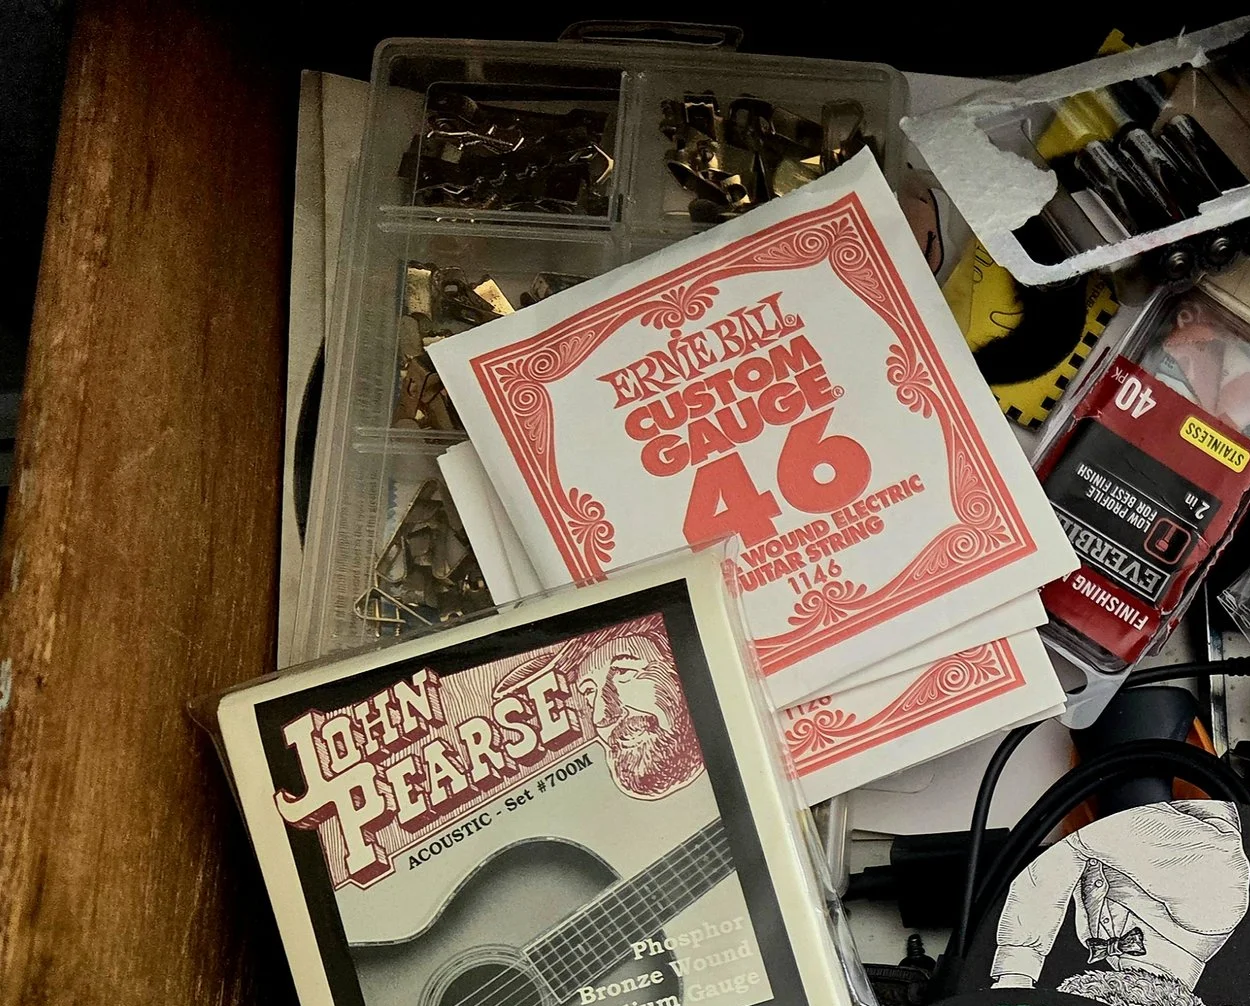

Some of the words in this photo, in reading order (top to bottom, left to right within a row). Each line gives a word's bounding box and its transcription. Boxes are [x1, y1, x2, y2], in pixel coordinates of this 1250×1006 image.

[596, 329, 717, 409] ERNIE
[707, 292, 805, 364] BALL
[625, 335, 822, 441] CUSTOM
[1110, 365, 1126, 383] PK
[1114, 376, 1156, 419] 40
[641, 364, 841, 477] GAUGE
[1183, 420, 1246, 466] STAINLESS
[683, 407, 871, 553] 46
[1075, 462, 1112, 491] FINISH
[1110, 481, 1137, 507] BEST
[741, 520, 830, 567] WOUND
[831, 474, 925, 528] ELECTRIC
[1086, 484, 1126, 520] PROFILE
[1125, 507, 1151, 532] LOW
[1136, 497, 1157, 519] FOR
[1184, 490, 1197, 511] in
[1196, 501, 1210, 519] 2
[805, 516, 884, 563] STRING
[788, 559, 842, 595] 1146
[1072, 574, 1148, 629] FINISHING
[273, 667, 444, 826] JOHN
[326, 670, 582, 885] PEARSE
[408, 812, 493, 870] ACOUSTIC
[504, 788, 535, 813] Set
[537, 752, 594, 793] #700M
[631, 916, 745, 961] Phosphor
[577, 970, 664, 1006] Bronze
[669, 940, 754, 978] Wound
[684, 971, 761, 1002] Gauge
